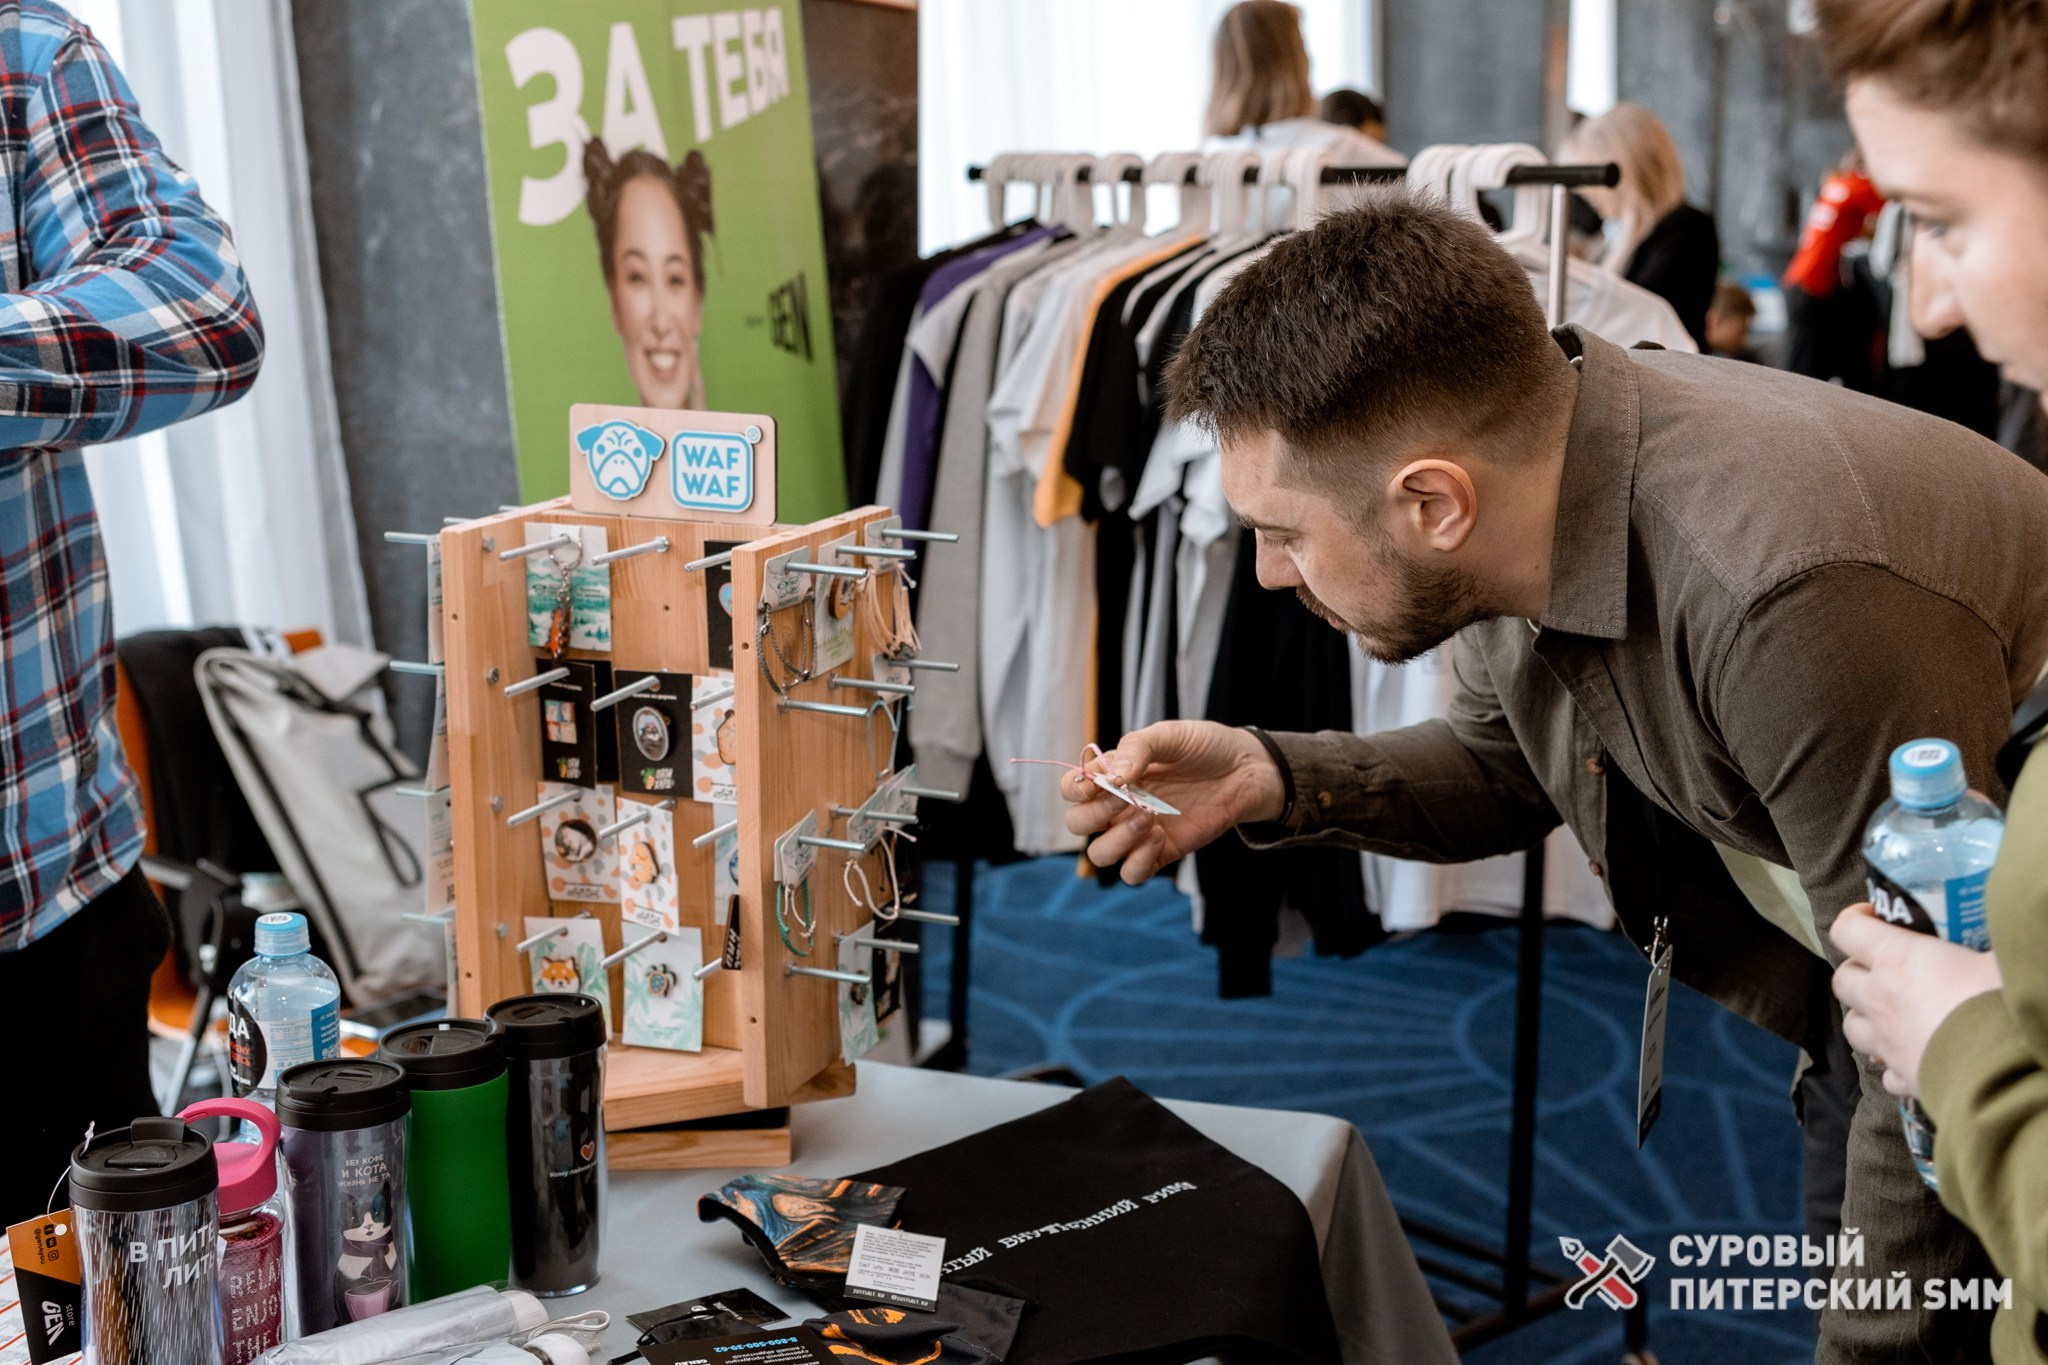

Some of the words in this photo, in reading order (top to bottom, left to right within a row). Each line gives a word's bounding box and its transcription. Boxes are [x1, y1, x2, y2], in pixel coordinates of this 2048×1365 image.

[505, 22, 669, 226] ЗА
[672, 6, 790, 143] ТЕБЯ
[682, 444, 740, 470] WAF
[682, 472, 740, 498] WAF
[342, 1169, 349, 1178] И
[355, 1162, 387, 1177] КОТА
[362, 1154, 384, 1165] КОФЕ
[337, 1179, 366, 1187] ЖИЗНЬ
[368, 1175, 379, 1184] НЕ
[381, 1172, 391, 1180] ТА
[34, 1228, 45, 1264] @gen4you
[129, 1241, 148, 1263] В
[42, 1301, 64, 1346] GEN
[66, 1304, 75, 1326] store
